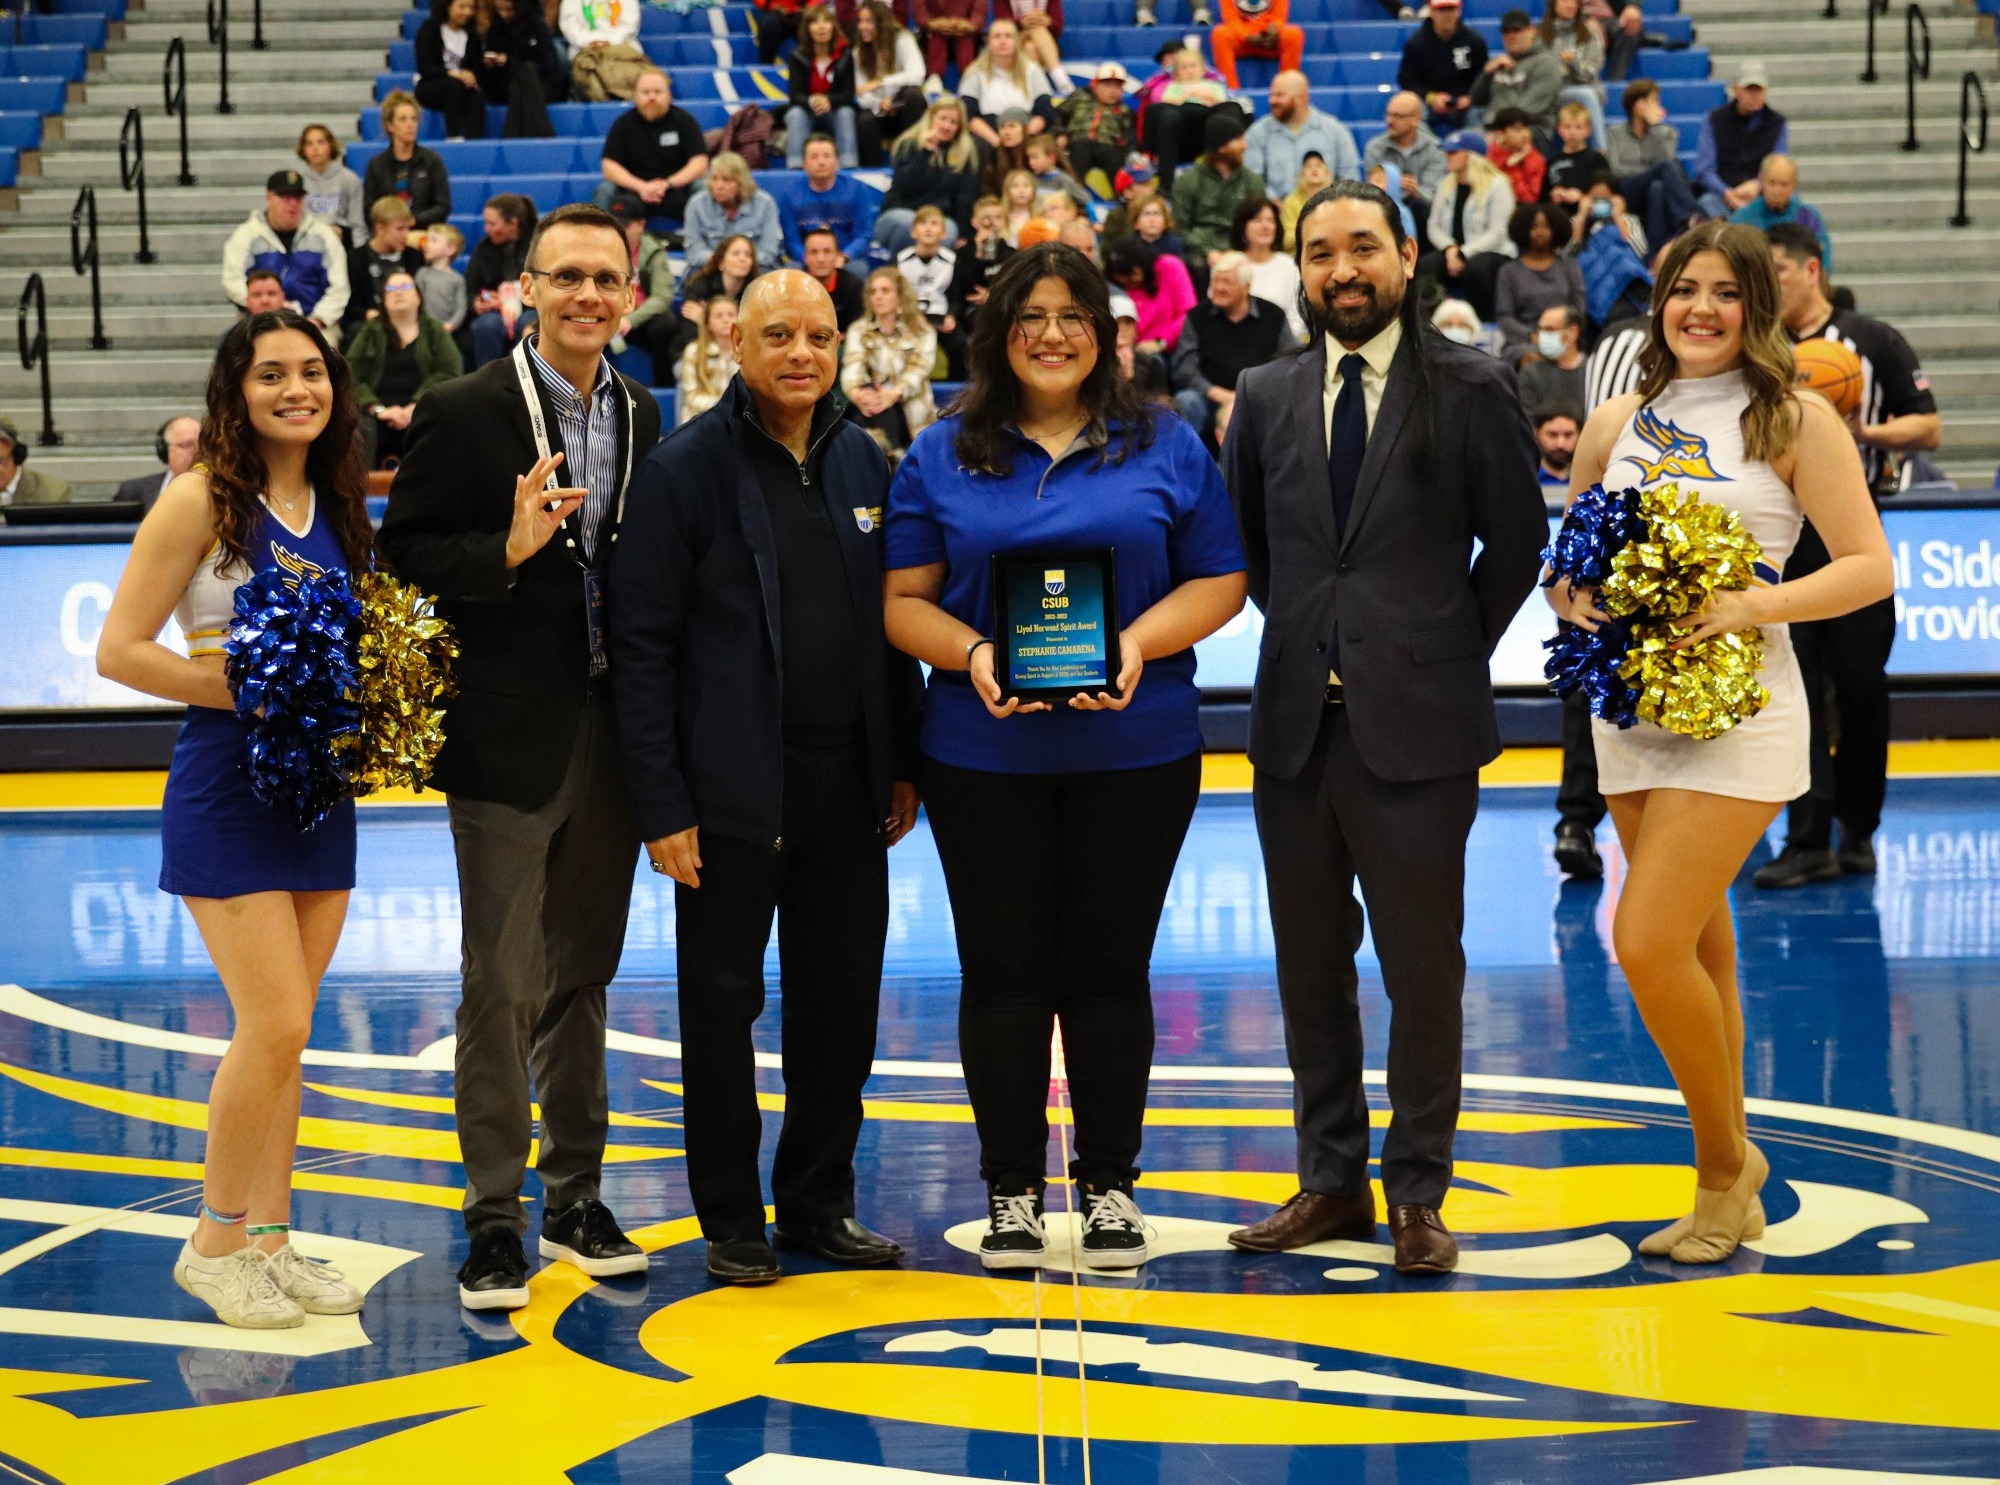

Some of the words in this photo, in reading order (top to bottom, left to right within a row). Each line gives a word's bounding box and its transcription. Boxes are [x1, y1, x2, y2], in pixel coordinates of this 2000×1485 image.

[1041, 596, 1070, 609] CSUB
[1894, 594, 2000, 641] rovi
[1033, 623, 1060, 633] Norwood
[1060, 622, 1077, 632] Spirit
[1077, 621, 1097, 630] Award
[1018, 646, 1057, 657] STEPHANIE
[1057, 644, 1096, 655] CAMARENA
